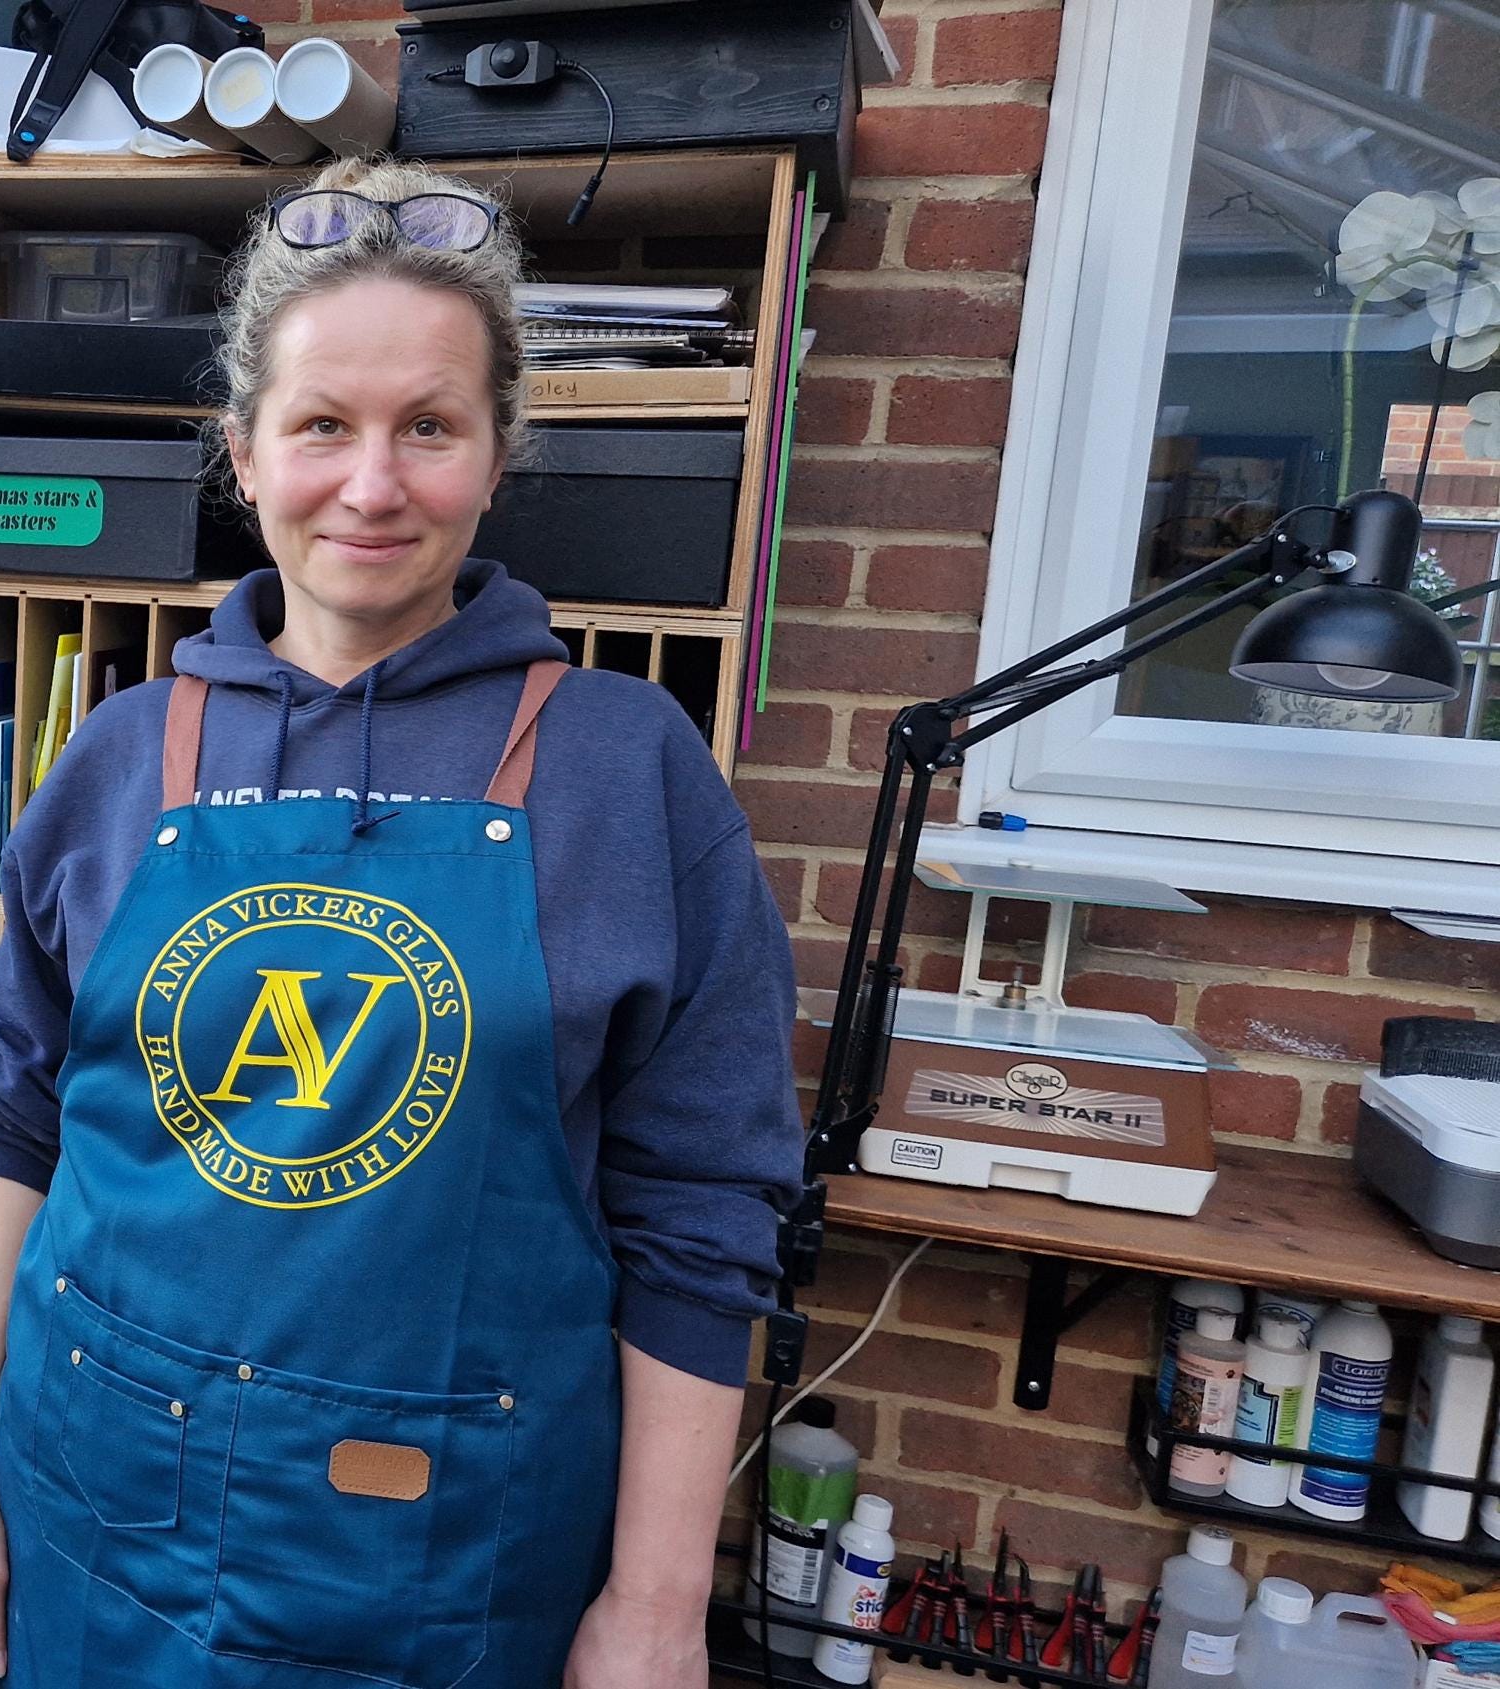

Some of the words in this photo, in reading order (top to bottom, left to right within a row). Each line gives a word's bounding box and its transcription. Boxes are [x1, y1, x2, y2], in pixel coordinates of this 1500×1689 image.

[33, 489, 81, 507] stars
[85, 489, 98, 508] &
[151, 917, 229, 1002] ANNA
[230, 893, 385, 929] VICKERS
[386, 920, 459, 1018] GLASS
[281, 1143, 391, 1198] WITH
[386, 1051, 457, 1153] LOVE
[930, 1089, 1027, 1113] SUPER
[1038, 1103, 1113, 1124] STAR
[1124, 1114, 1141, 1128] II
[897, 1143, 938, 1157] CAUTION
